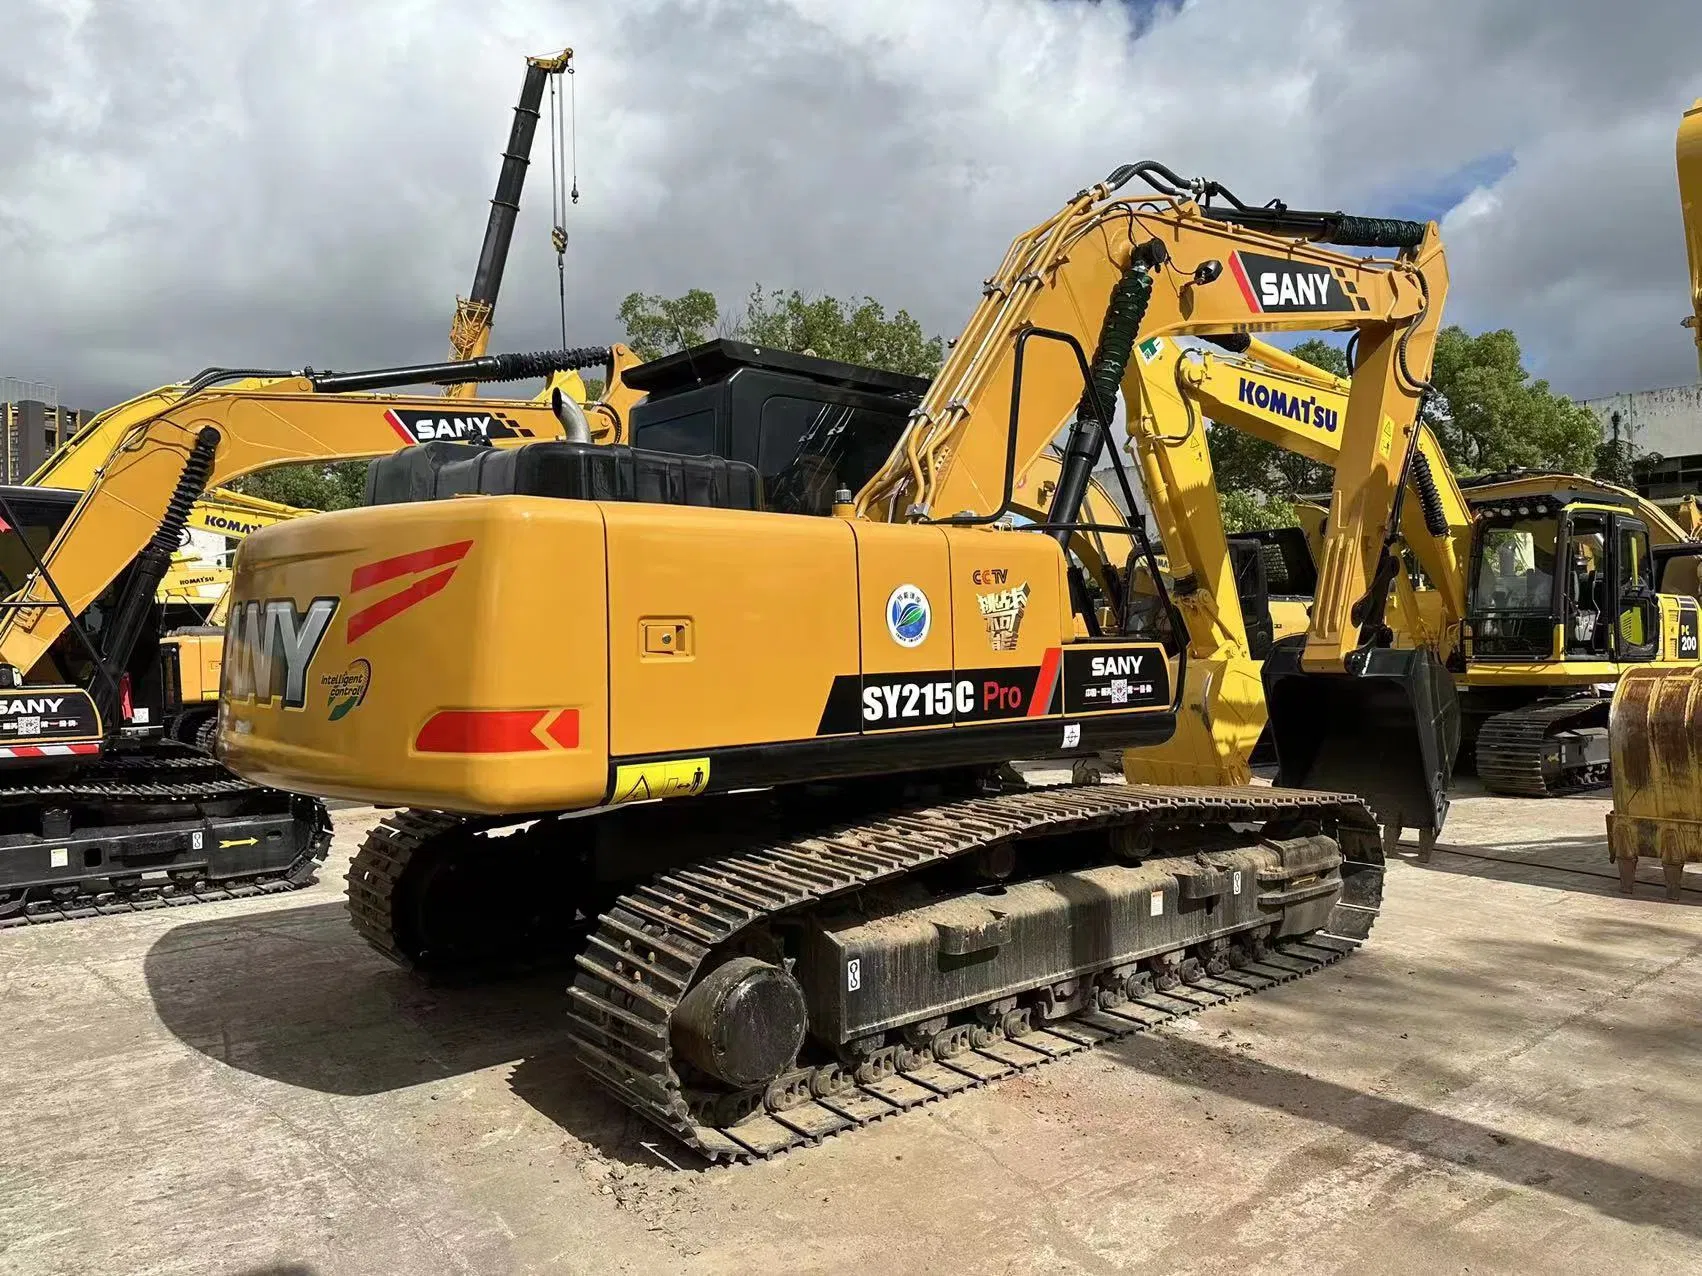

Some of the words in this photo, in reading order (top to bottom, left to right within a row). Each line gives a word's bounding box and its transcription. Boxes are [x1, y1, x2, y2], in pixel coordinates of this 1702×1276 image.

[1260, 272, 1330, 306] SANY
[1239, 377, 1338, 433] KOMATSU
[415, 416, 491, 440] SANY
[205, 515, 262, 535] KOMAT
[179, 576, 215, 586] KOMATSU
[972, 569, 1008, 585] CCTV
[1681, 624, 1690, 636] PC
[1681, 636, 1697, 651] 200
[1091, 655, 1143, 677] SANY
[862, 680, 975, 722] SY215C
[983, 681, 1022, 711] Pro
